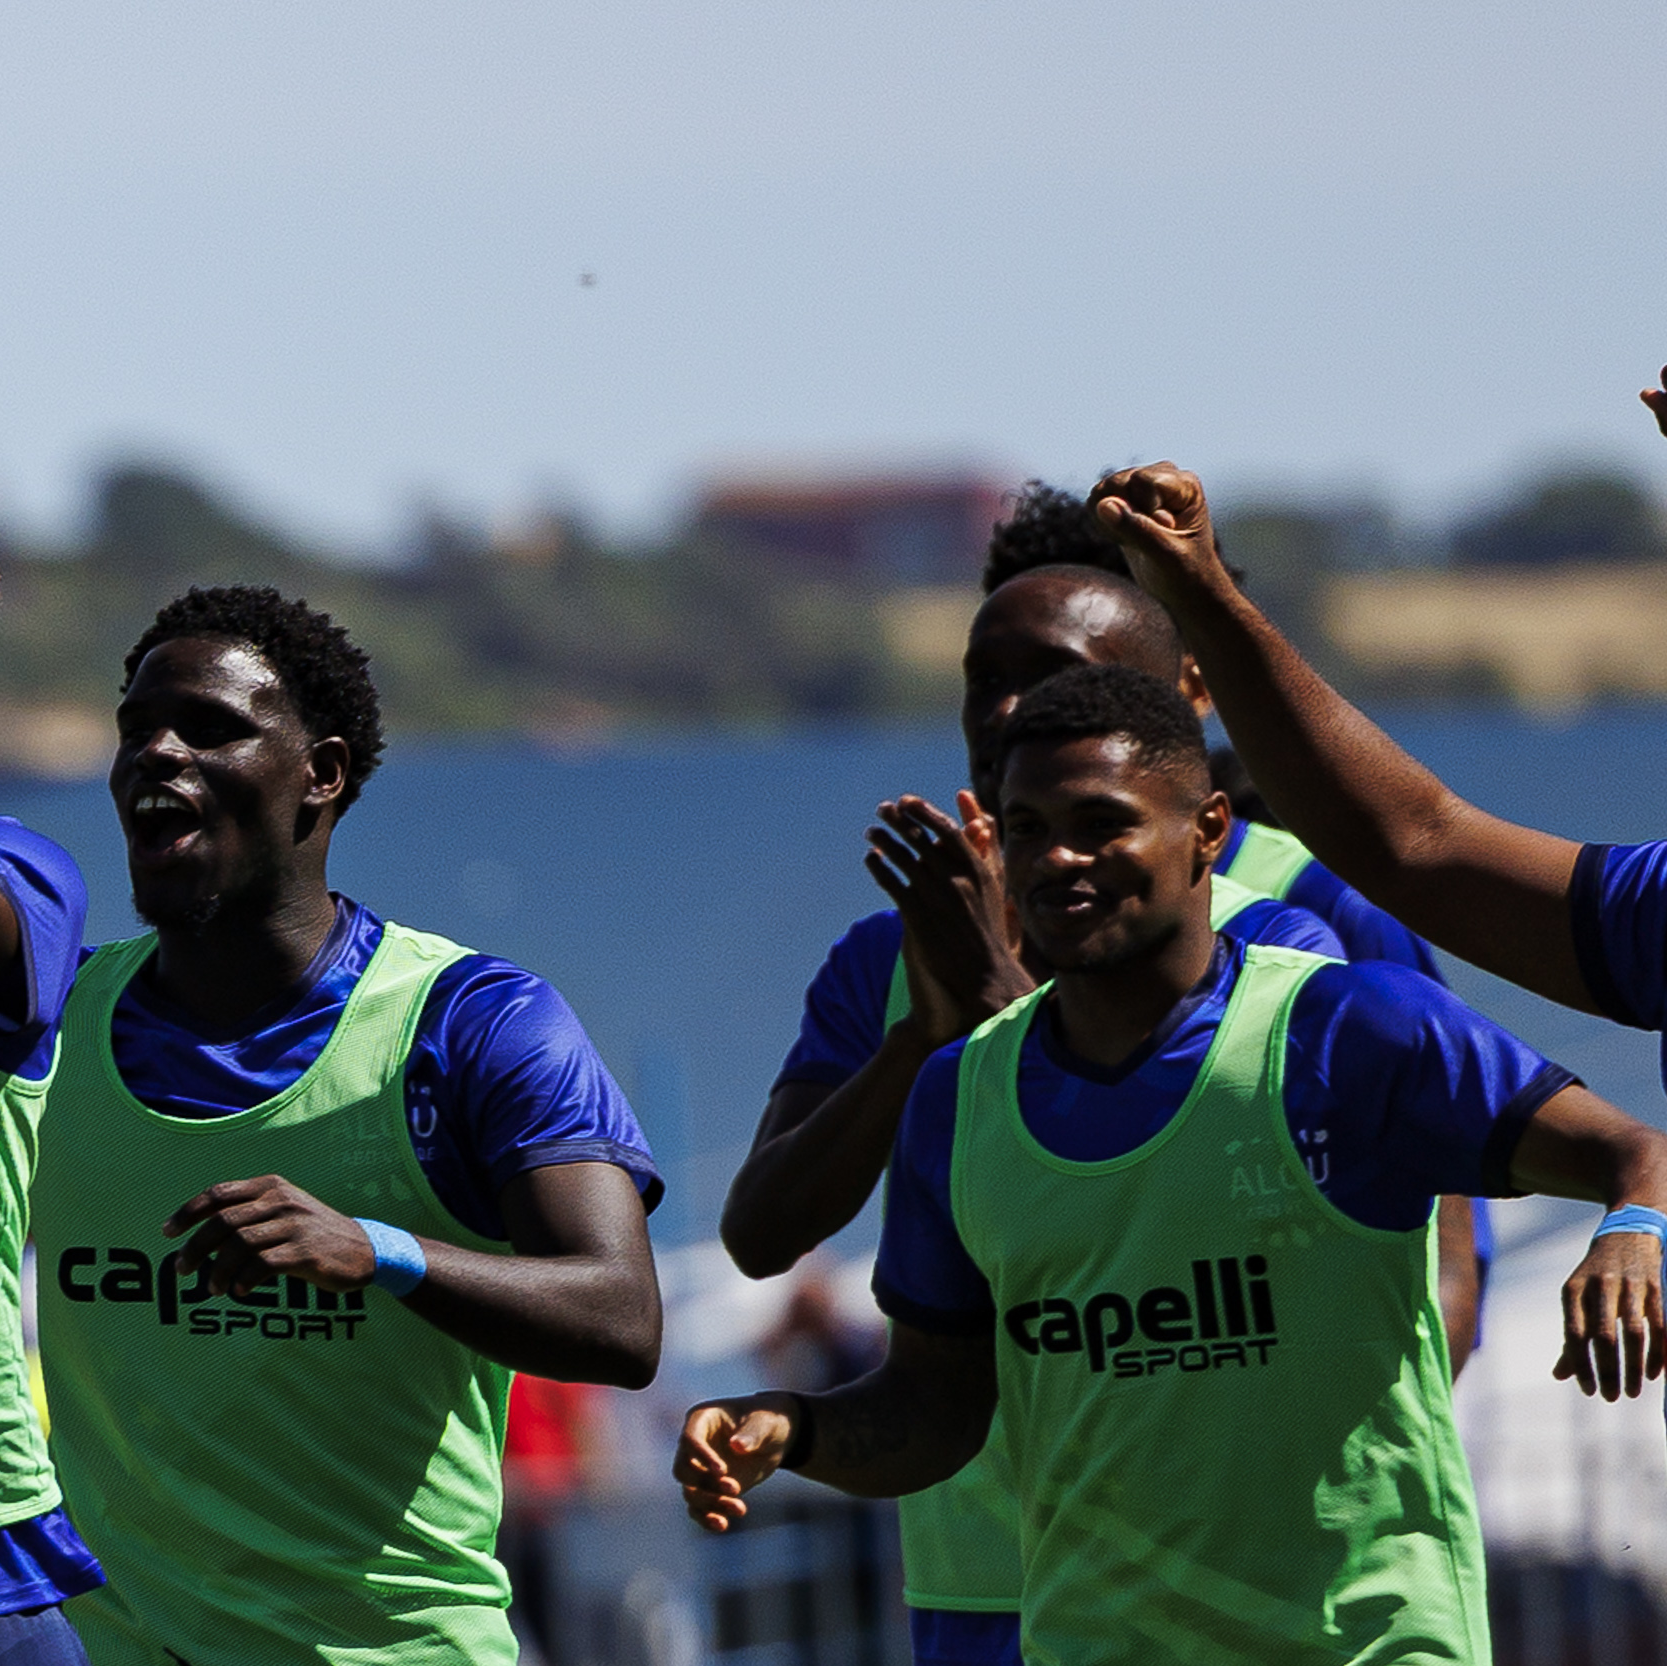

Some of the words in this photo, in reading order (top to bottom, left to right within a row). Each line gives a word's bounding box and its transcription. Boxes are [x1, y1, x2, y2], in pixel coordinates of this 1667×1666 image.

[189, 1308, 366, 1340] SPORT
[1004, 1254, 1276, 1373] capelli
[1113, 1338, 1278, 1378] SPORT
